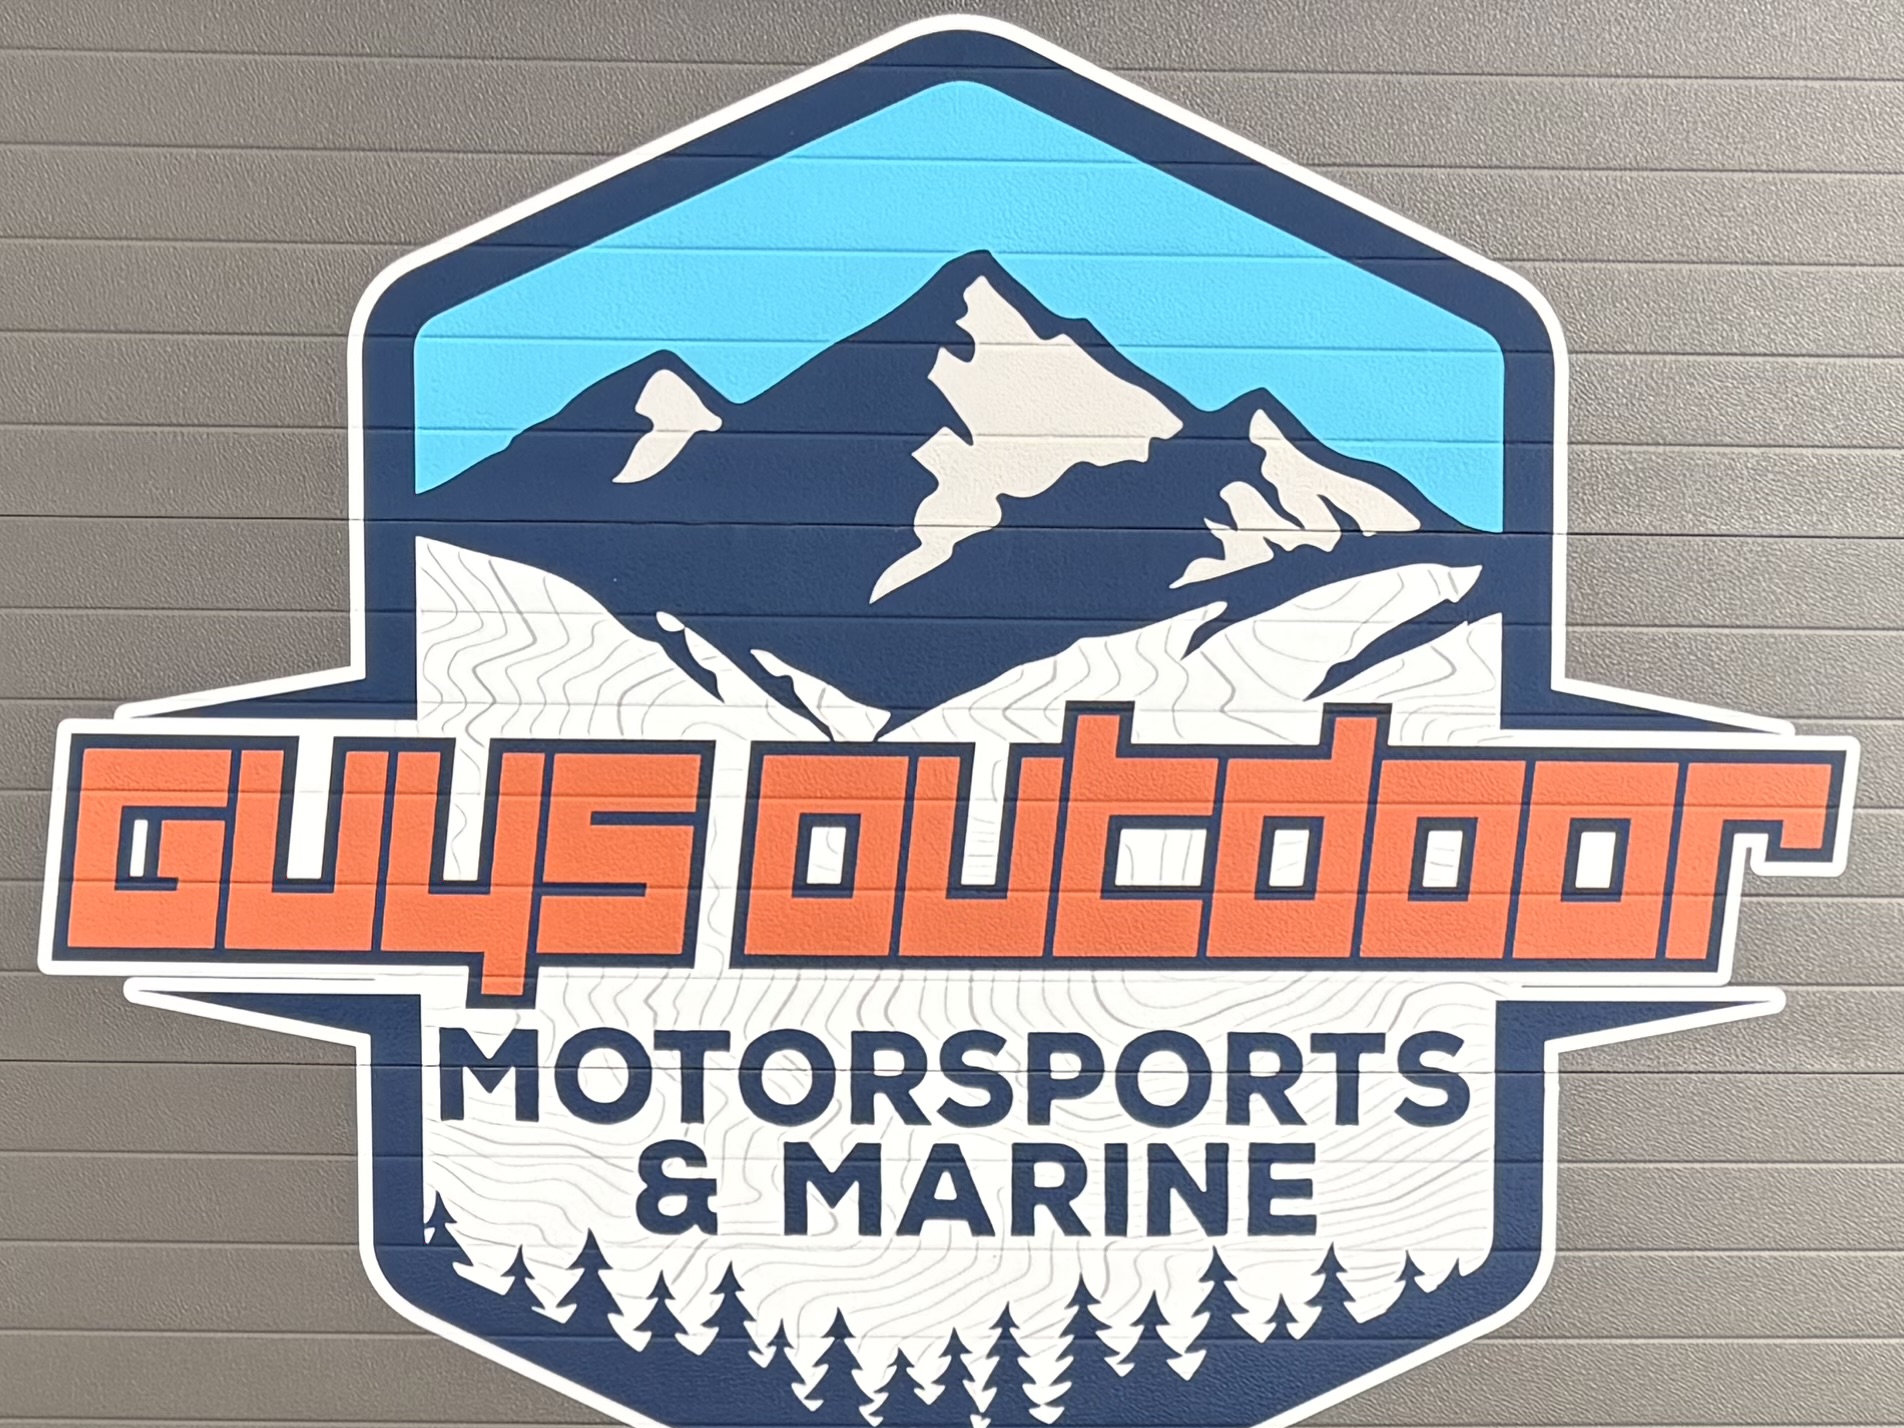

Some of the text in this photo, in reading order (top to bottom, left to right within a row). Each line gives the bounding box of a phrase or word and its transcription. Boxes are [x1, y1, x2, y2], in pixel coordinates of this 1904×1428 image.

[438, 1026, 1471, 1129] MOTORSPORTS
[635, 1138, 1318, 1237] & MARINE
